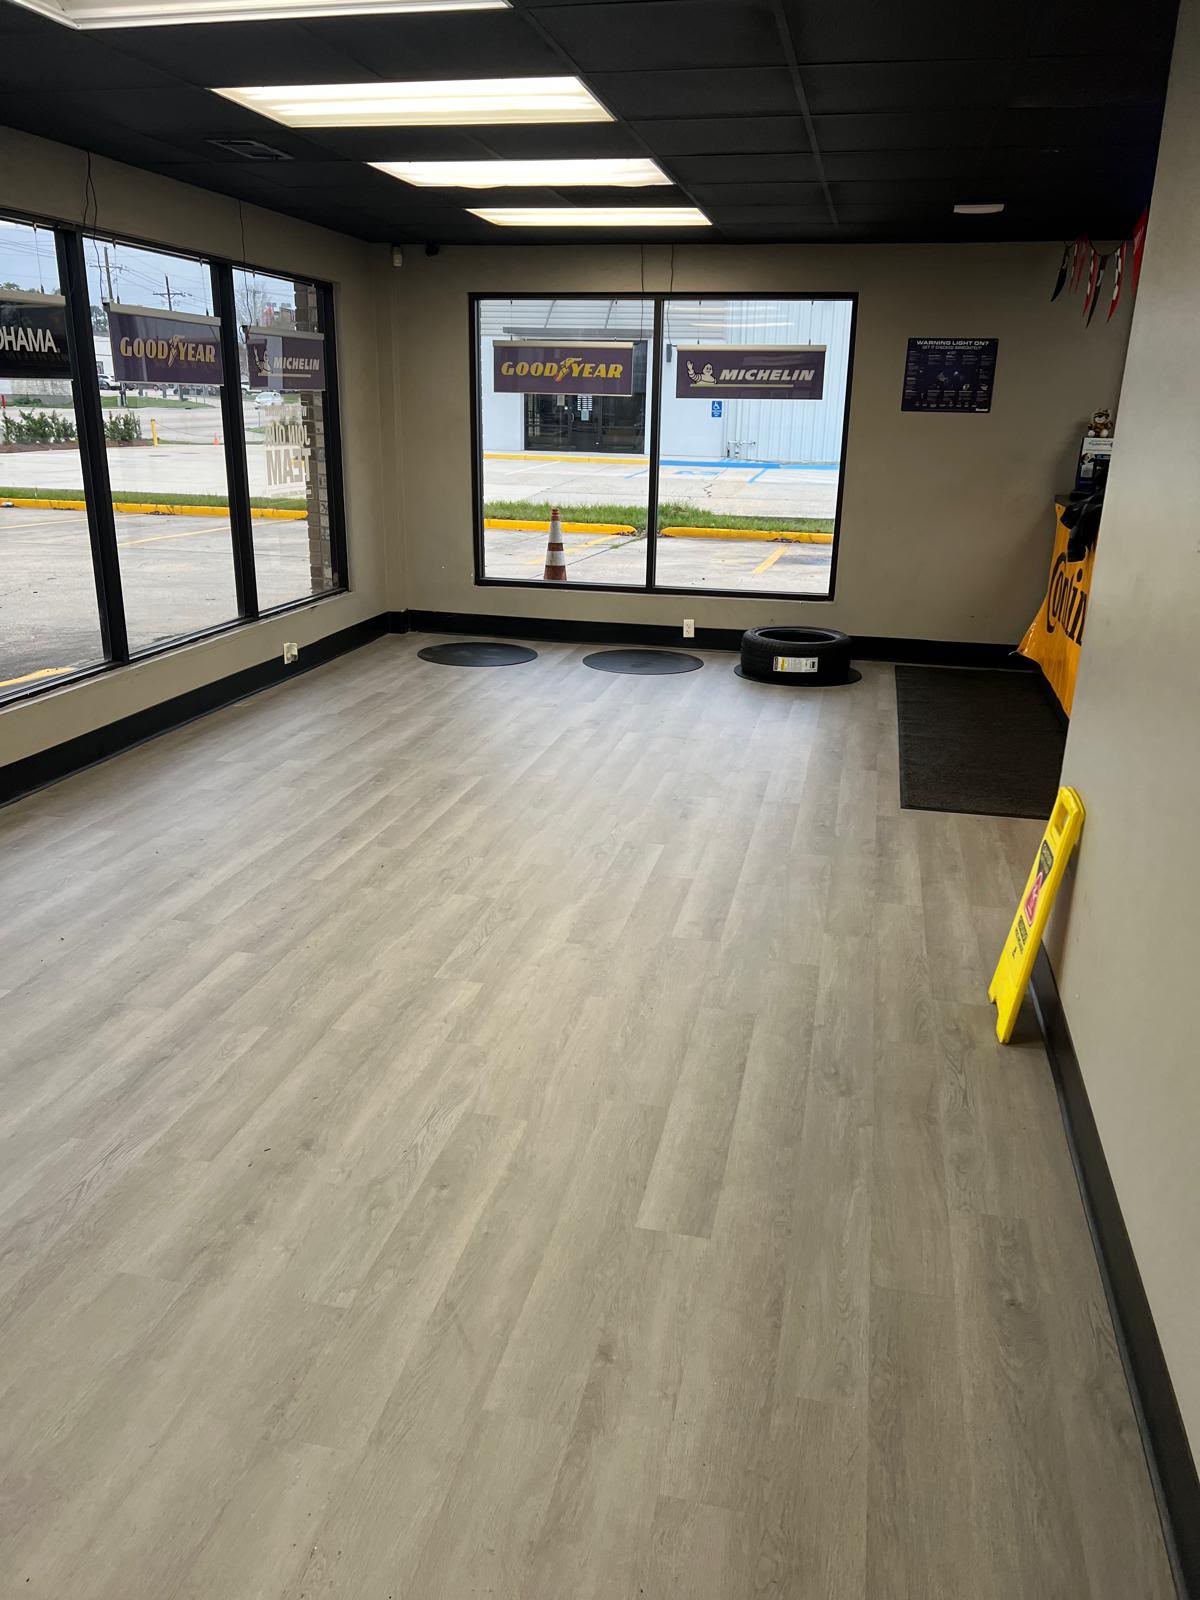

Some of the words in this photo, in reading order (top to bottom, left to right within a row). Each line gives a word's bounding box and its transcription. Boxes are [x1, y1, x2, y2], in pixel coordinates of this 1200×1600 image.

[120, 336, 216, 363] GOODYEAR
[273, 356, 320, 371] MICHELIN
[501, 361, 623, 379] GOODYEAR
[719, 369, 815, 381] MICHELIN
